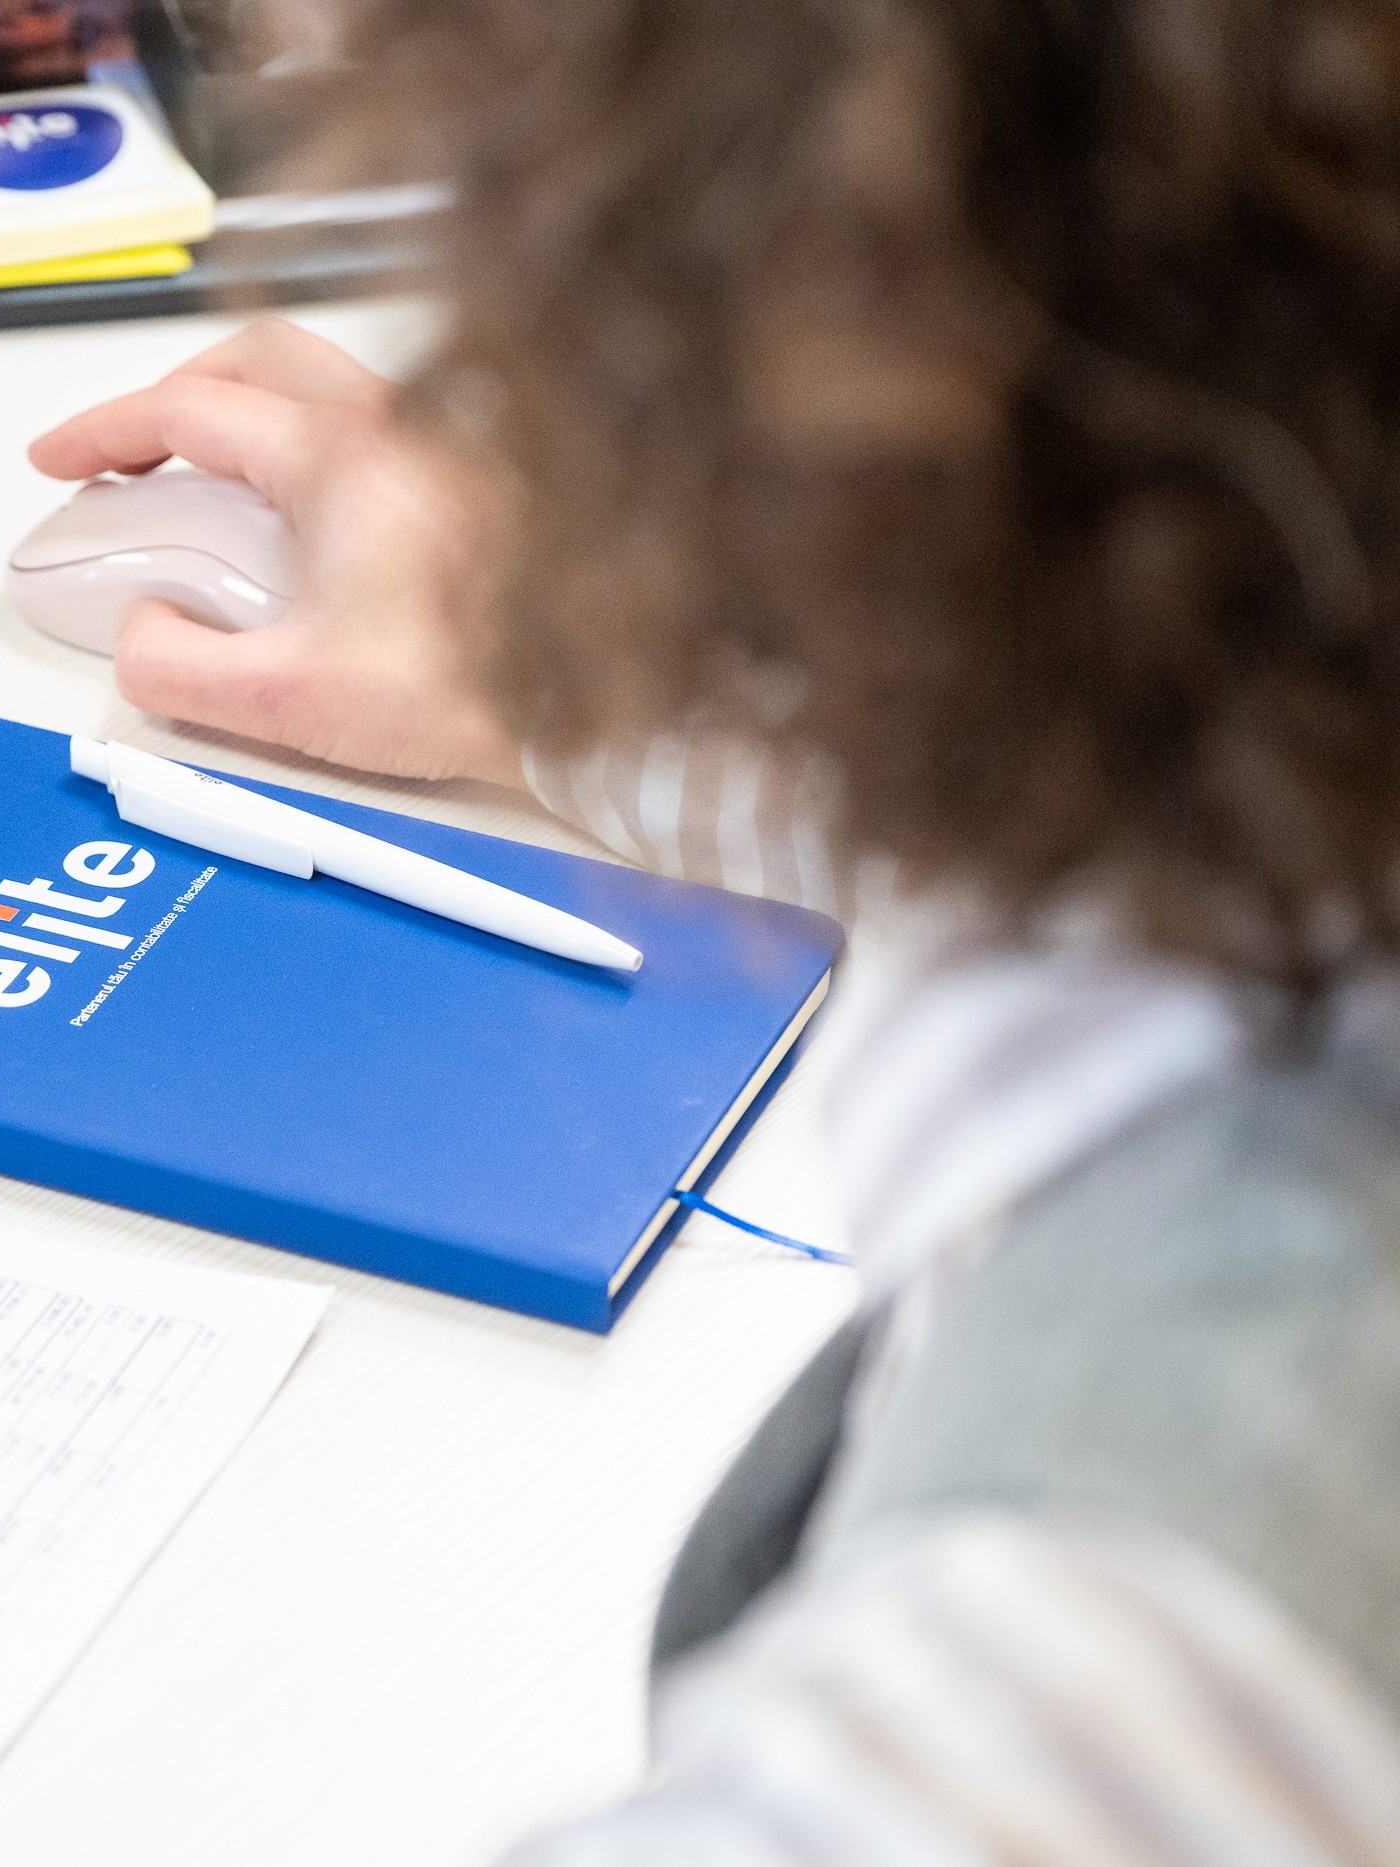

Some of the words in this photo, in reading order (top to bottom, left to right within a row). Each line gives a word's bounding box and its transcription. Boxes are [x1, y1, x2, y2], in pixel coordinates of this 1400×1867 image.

[70, 984, 116, 1027] Partenerul
[130, 911, 178, 961] contabilitate
[176, 866, 218, 905] fiscalitate
